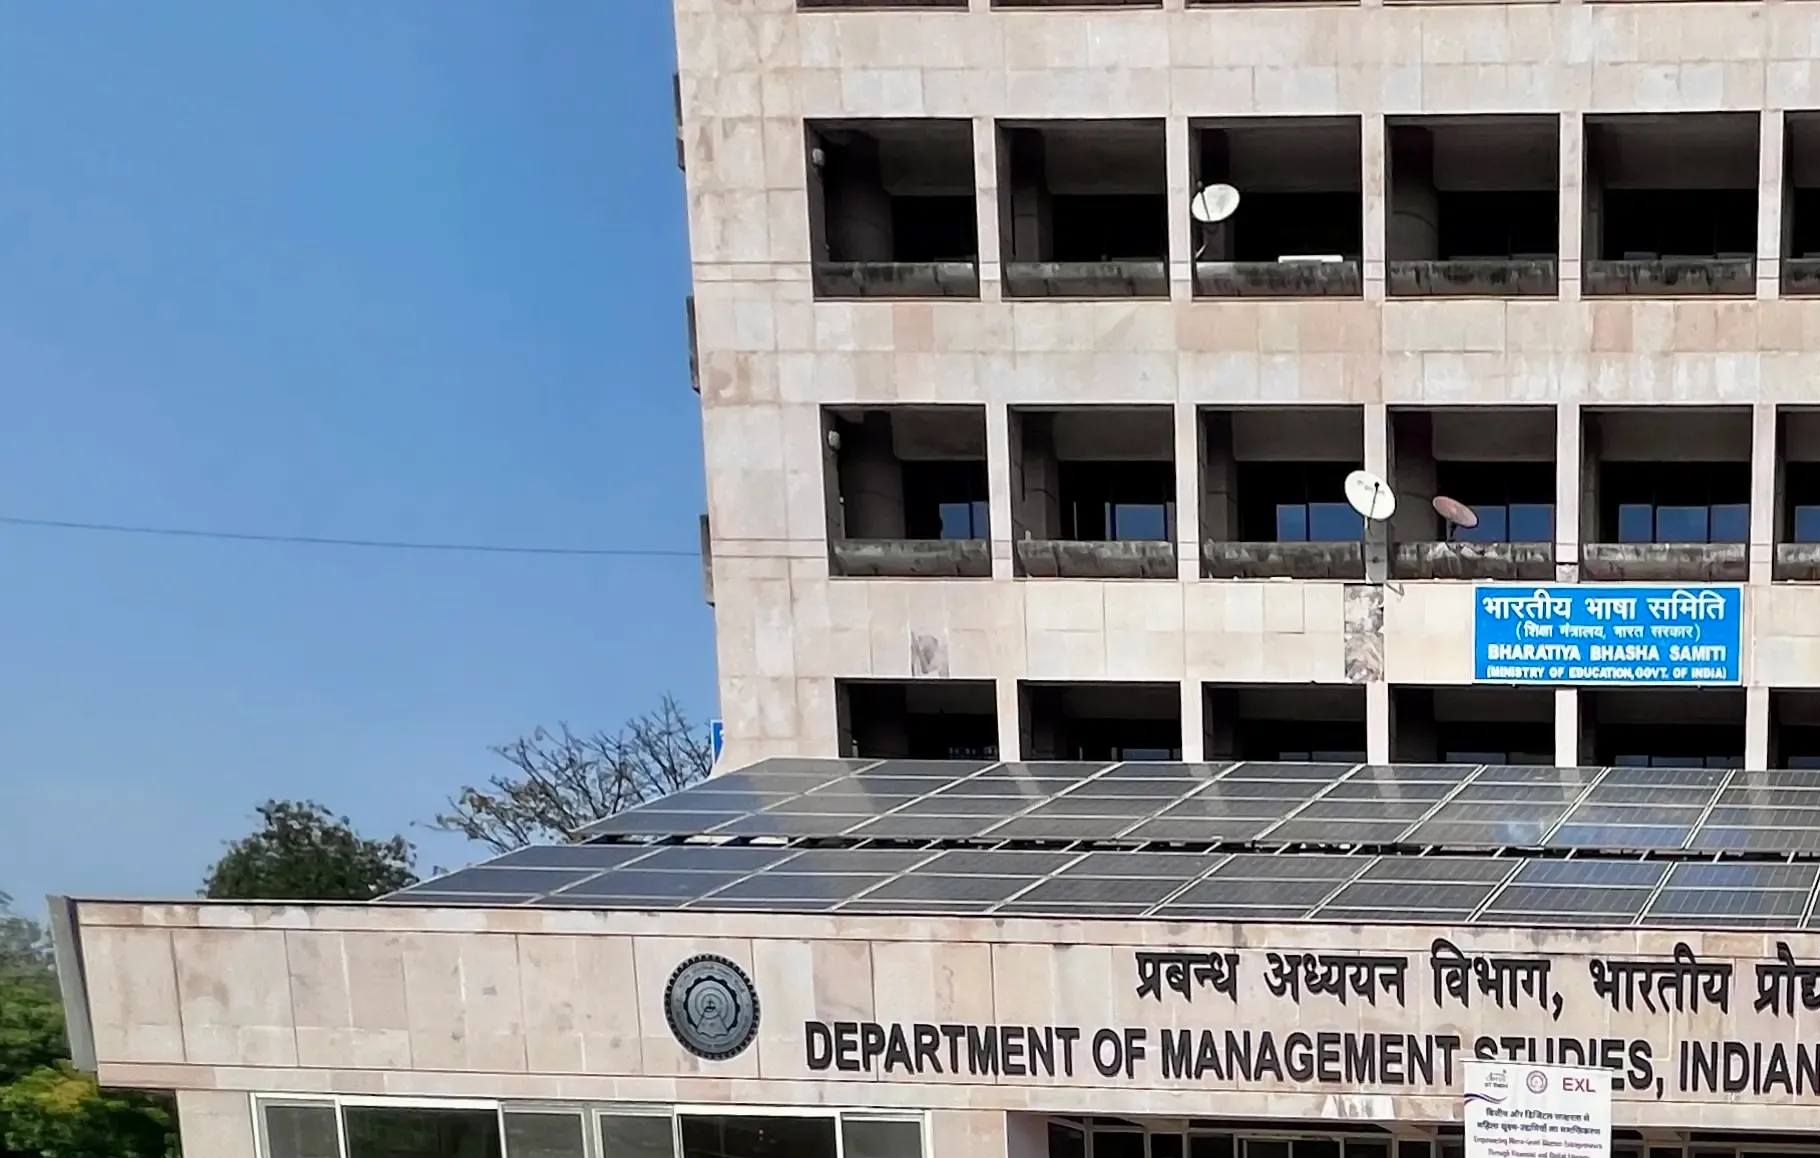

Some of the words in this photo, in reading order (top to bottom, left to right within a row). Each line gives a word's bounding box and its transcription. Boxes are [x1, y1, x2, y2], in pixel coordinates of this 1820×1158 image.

[1482, 588, 1573, 620] भारतीय
[1584, 597, 1637, 621] भाषा
[1646, 588, 1727, 621] समिति
[1613, 624, 1644, 639] भारत
[1487, 644, 1581, 661] BHARATIYA
[1590, 644, 1660, 661] BHASHA
[1669, 644, 1727, 661] SAMITI
[1549, 666, 1565, 679] OF
[1672, 666, 1688, 679] OF
[1134, 951, 1241, 1005] प्रबन्ध
[1263, 952, 1408, 1009] अध्ययन
[1430, 937, 1564, 1022] विभाग,
[1589, 940, 1735, 1018] भारतीय
[804, 1019, 1082, 1077] DEPARTMENT
[1091, 1026, 1147, 1081] OF
[1160, 1028, 1461, 1087] MANAGEMENT
[1562, 1077, 1597, 1093] EXL
